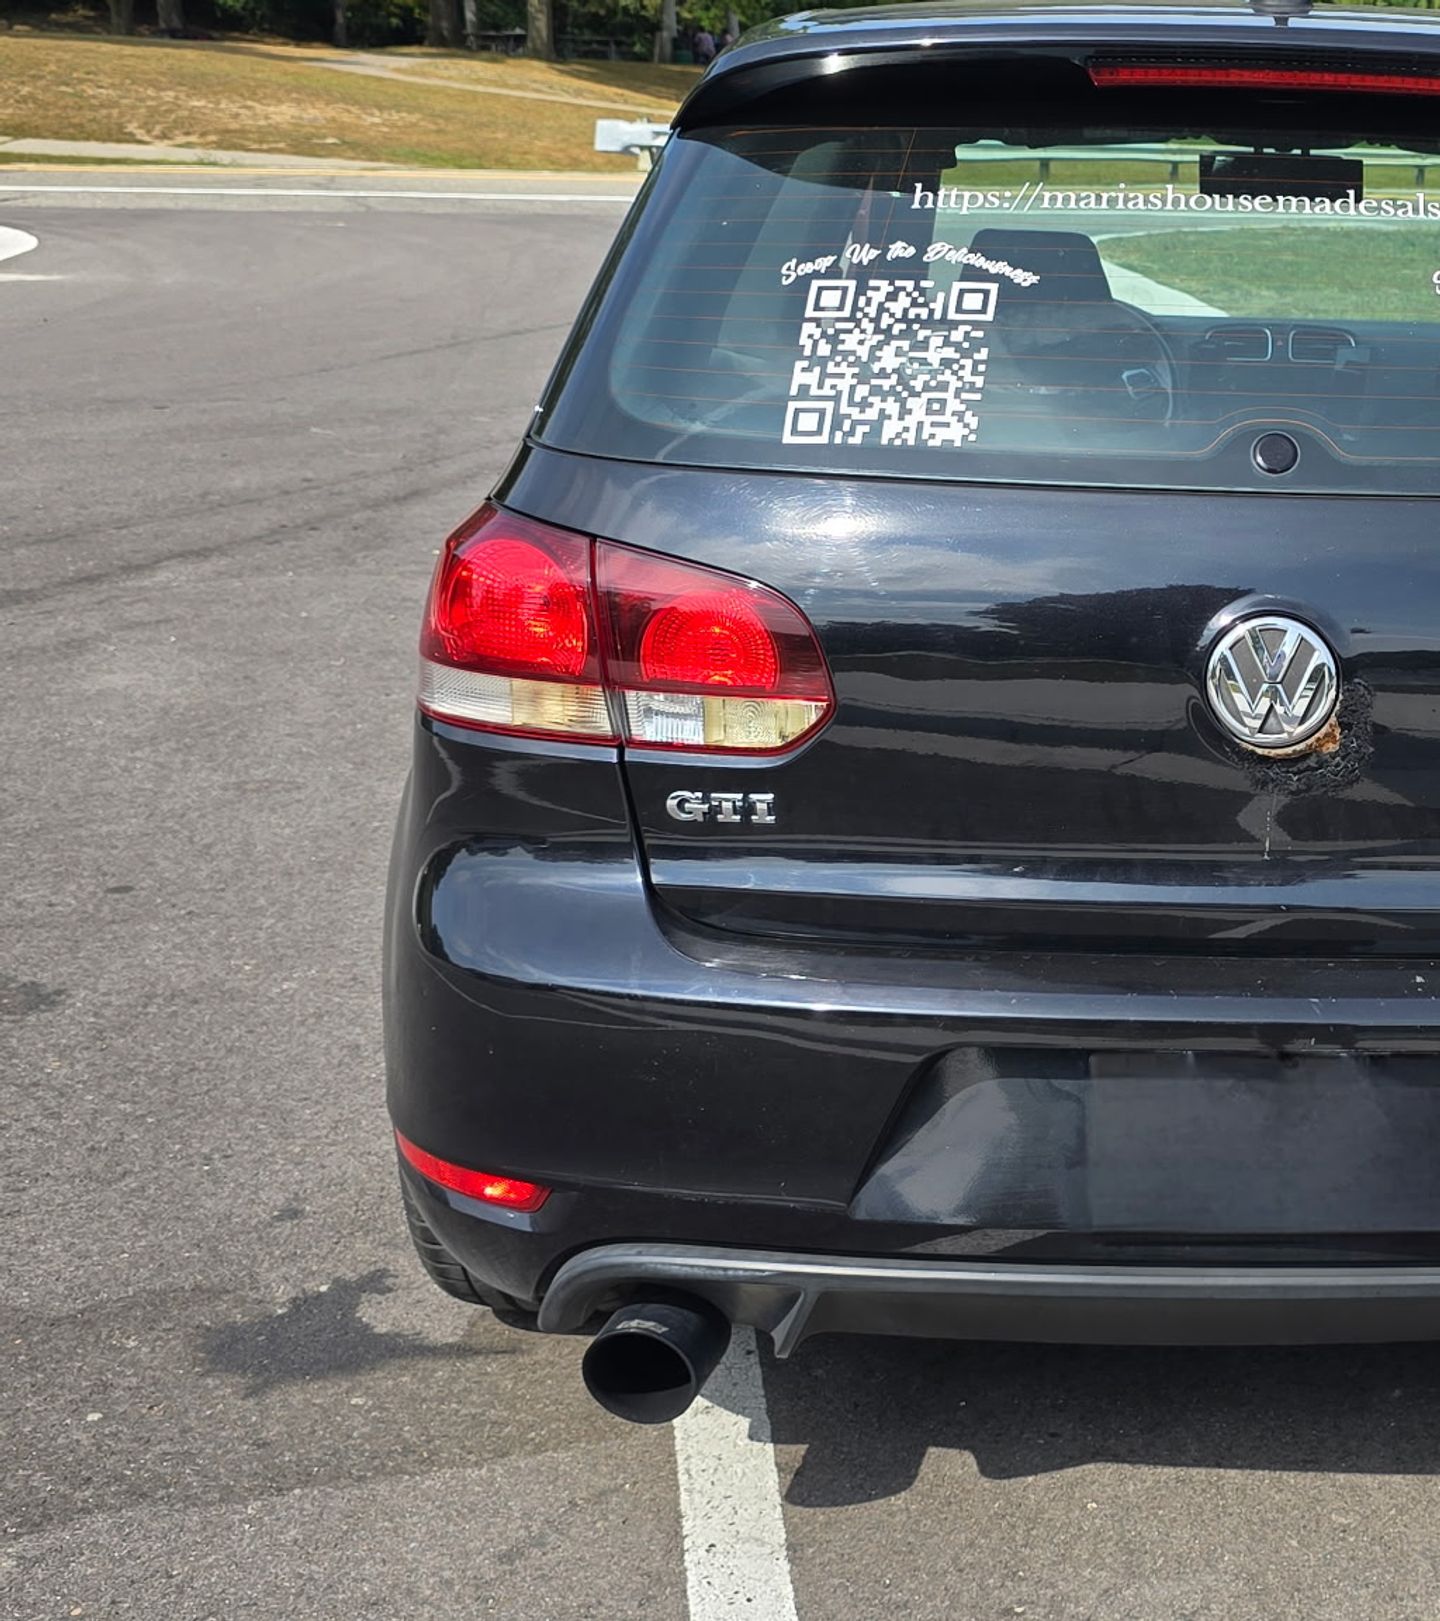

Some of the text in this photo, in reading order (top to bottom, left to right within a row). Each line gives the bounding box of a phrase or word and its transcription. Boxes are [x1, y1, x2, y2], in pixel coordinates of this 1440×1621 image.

[781, 240, 1041, 287] Scoop Up the Deliciousness
[666, 790, 776, 823] GTI
